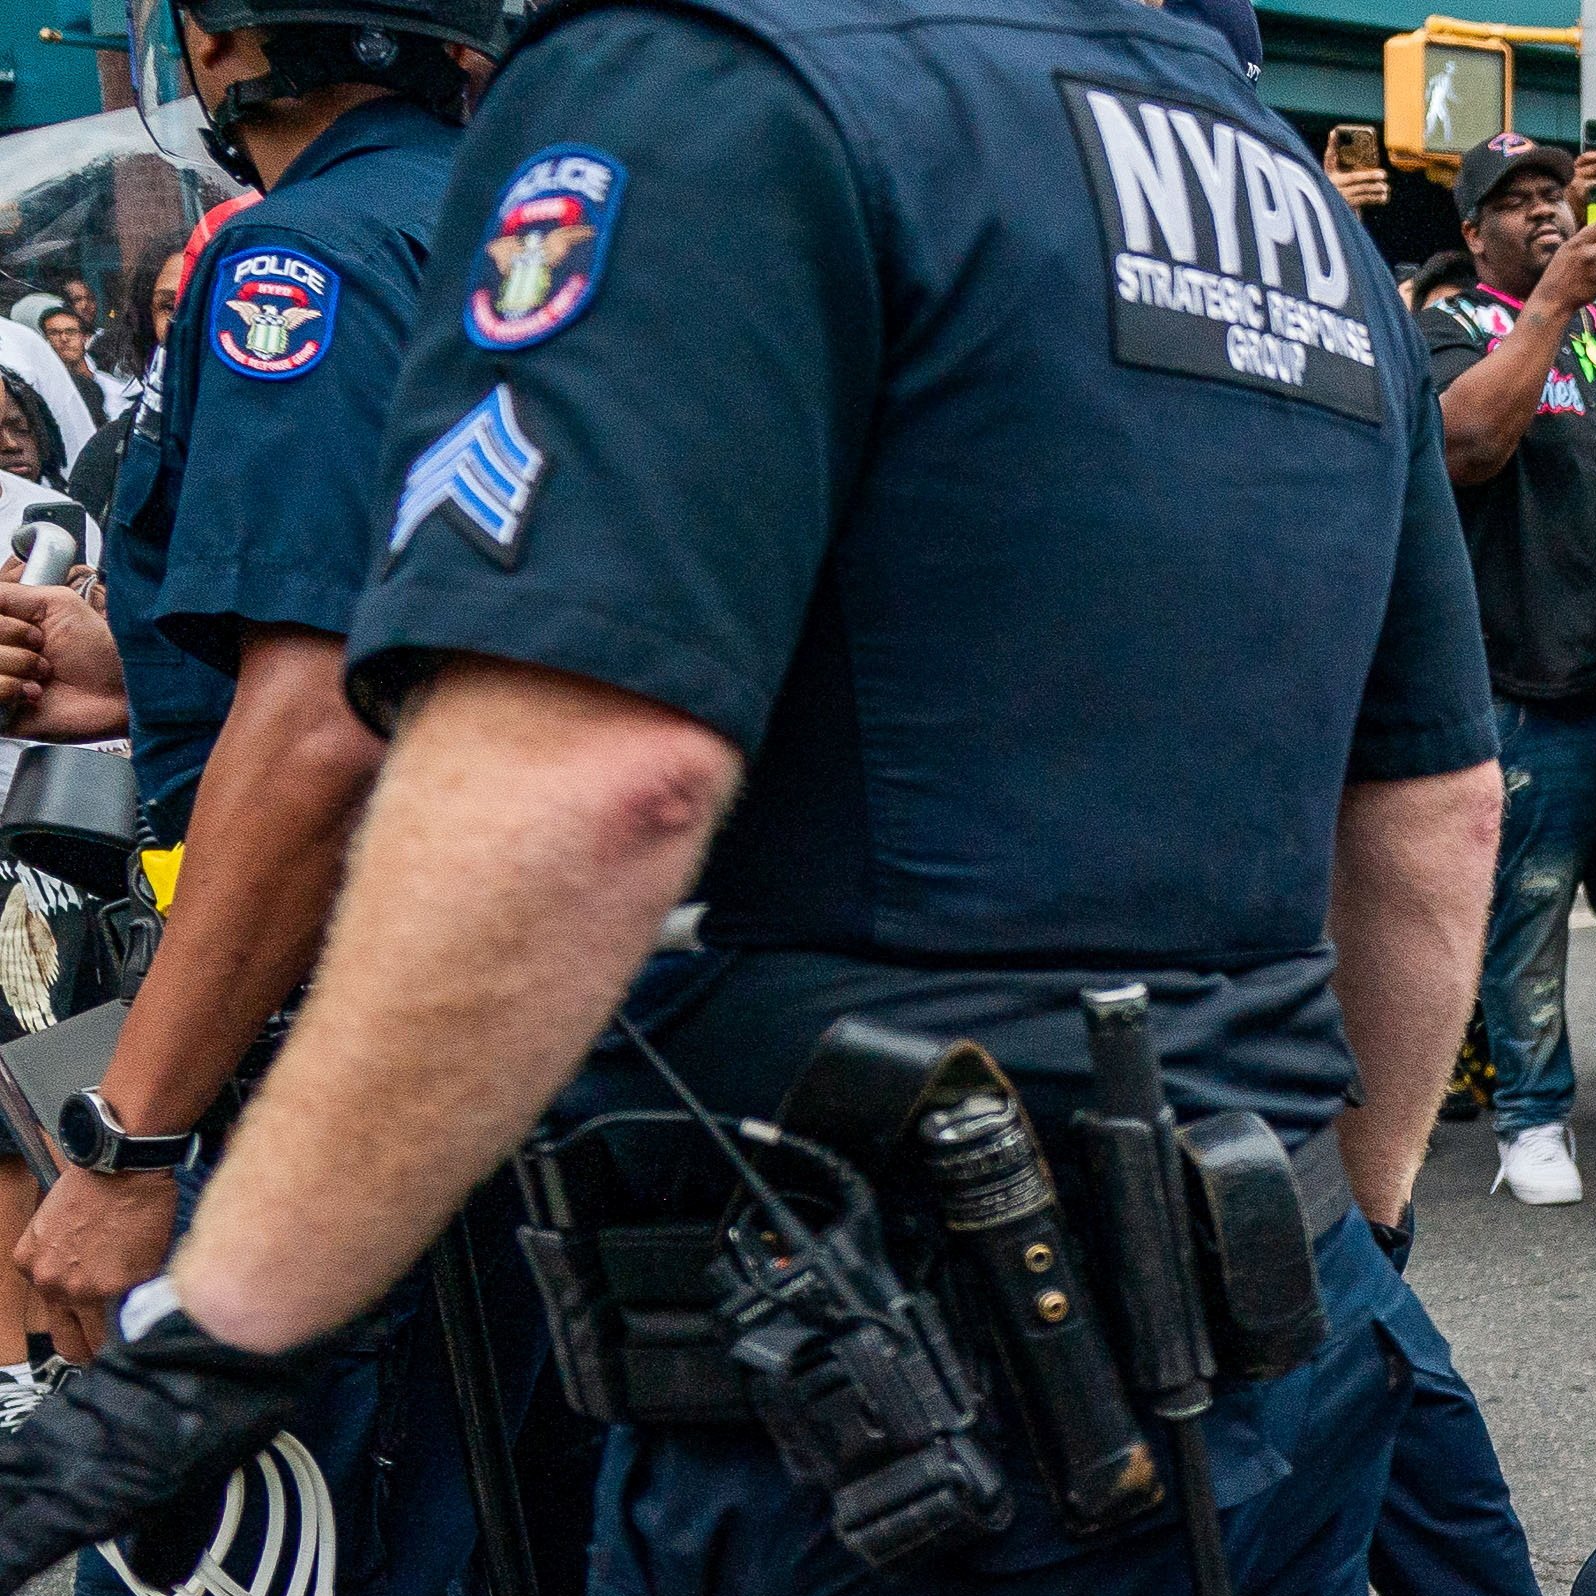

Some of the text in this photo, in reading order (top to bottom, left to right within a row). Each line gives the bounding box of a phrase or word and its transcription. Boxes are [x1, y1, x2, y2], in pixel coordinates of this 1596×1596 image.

[1086, 90, 1350, 309] NYPD
[234, 255, 325, 296] POLICE
[1115, 253, 1376, 368] STRATEGIC RESPONSE
[1226, 324, 1307, 387] GROUP
